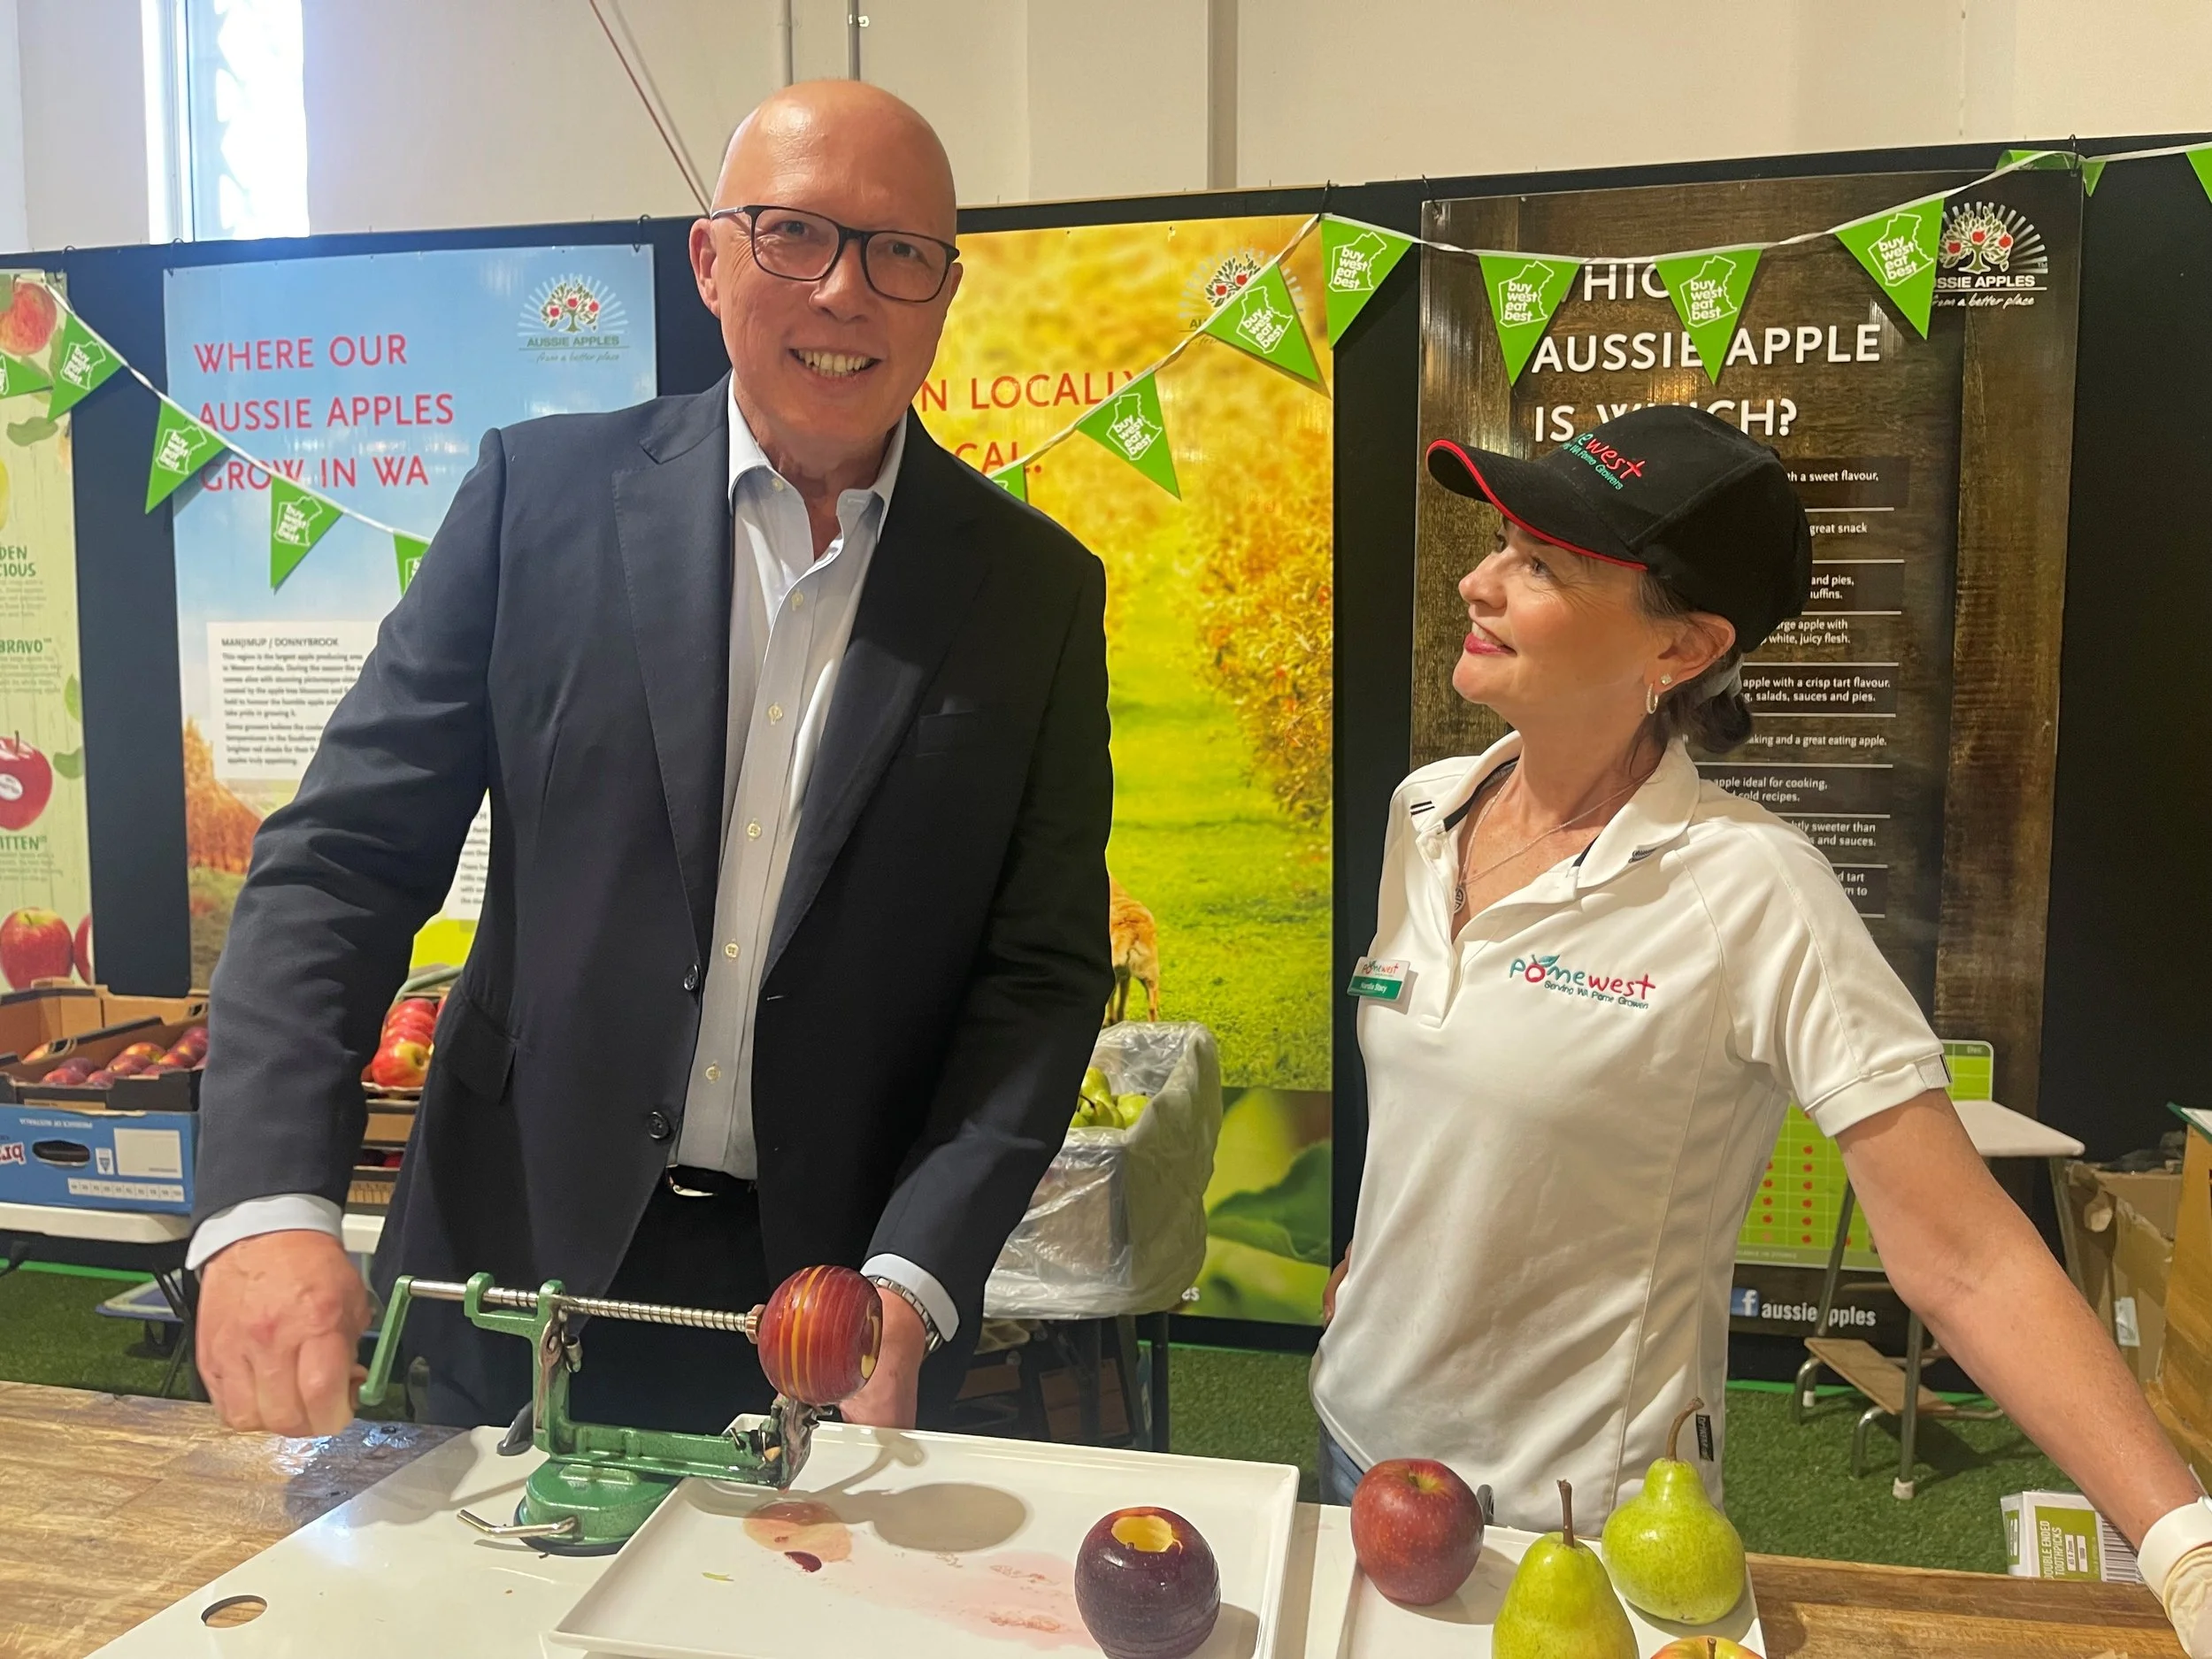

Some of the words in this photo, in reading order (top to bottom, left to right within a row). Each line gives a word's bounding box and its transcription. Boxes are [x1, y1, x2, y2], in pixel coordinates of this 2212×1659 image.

[1878, 235, 1904, 251] buy
[1341, 245, 1364, 263] buy
[1881, 241, 1914, 261] west
[1340, 257, 1368, 272] west
[1885, 256, 1908, 268] eat
[1336, 267, 1357, 279] eat
[1886, 261, 1917, 280] best
[1333, 274, 1360, 289] best
[1509, 280, 1532, 294] buy
[1584, 264, 1670, 301] HIC
[1690, 280, 1716, 291] buy
[1934, 276, 1971, 288] SSIE
[1975, 275, 2035, 288] APPLES
[1507, 291, 1538, 303] west
[1690, 286, 1723, 301] west
[1969, 293, 2003, 307] better
[2003, 293, 2034, 309] place
[1505, 302, 1528, 311] eat
[1692, 298, 1715, 310] eat
[1241, 308, 1263, 329] buy
[1504, 310, 1532, 322] best
[1692, 305, 1722, 320] best
[1248, 310, 1273, 334] west
[1256, 323, 1273, 342] eat
[1260, 325, 1284, 348] best
[526, 337, 570, 348] AUSSIE
[573, 335, 619, 347] APPLES
[1531, 331, 1703, 373] AUSSIE
[1725, 324, 1881, 366] APPLE
[194, 338, 314, 373] WHERE
[329, 334, 407, 366] OUR
[971, 371, 1134, 411] LOCALL
[199, 399, 312, 432] AUSSIE
[326, 394, 453, 427] APPLES
[1113, 414, 1133, 433] buy
[1118, 418, 1143, 440] west
[1535, 404, 1575, 442] IS
[1125, 430, 1142, 448] eat
[1127, 434, 1152, 455] best
[1577, 434, 1645, 479] ewest
[200, 458, 303, 491] GROW
[321, 458, 356, 488] IN
[373, 456, 429, 487] WA
[1809, 472, 1839, 481] sweet
[1809, 524, 1835, 537] great
[1838, 522, 1868, 533] snack
[1811, 574, 1829, 585] and
[1798, 618, 1824, 632] apple
[1827, 618, 1848, 629] with
[1800, 633, 1822, 646] juicy
[1743, 677, 1770, 689] apple
[1773, 677, 1794, 687] with
[1797, 679, 1802, 687] a
[1806, 677, 1831, 689] crisp
[1833, 678, 1851, 687] tart
[1793, 692, 1827, 702] sauces
[1830, 691, 1849, 702] and
[1775, 734, 1793, 745] and
[1795, 736, 1801, 745] a
[1802, 735, 1826, 748] great
[1828, 734, 1857, 748] eating
[1859, 734, 1887, 748] apple.
[1742, 776, 1767, 787] ideal
[1769, 776, 1784, 787] for
[1812, 823, 1850, 832] sweeter
[1853, 821, 1876, 833] than
[1817, 834, 1836, 845] and
[1839, 837, 1876, 847] sauces.
[1847, 872, 1864, 882] tart
[1857, 887, 1868, 896] to
[2052, 1527, 2065, 1575] TOOTHPICKS
